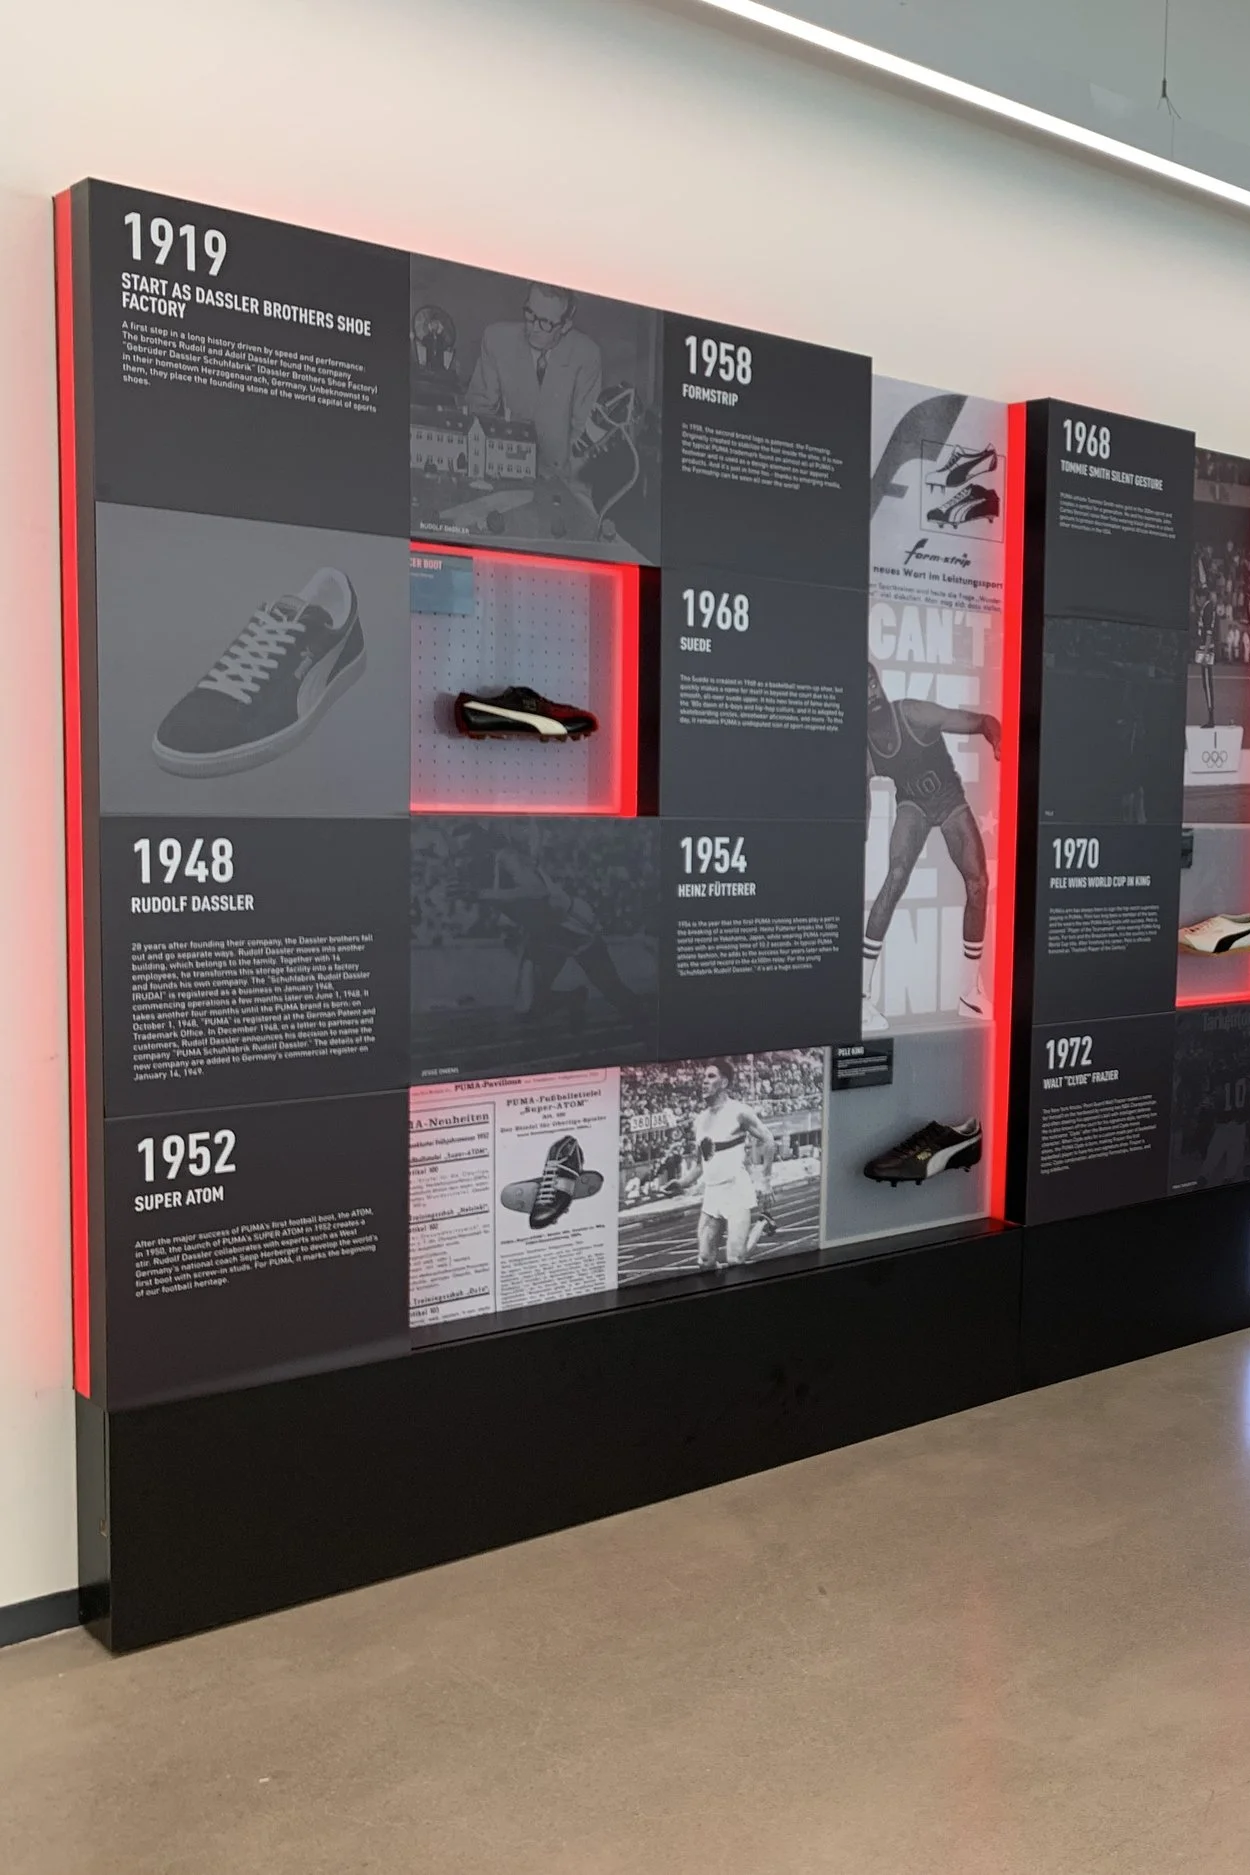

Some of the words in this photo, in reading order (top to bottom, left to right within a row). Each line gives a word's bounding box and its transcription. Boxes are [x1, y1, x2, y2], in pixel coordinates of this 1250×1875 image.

[124, 211, 227, 277] 1919
[122, 272, 168, 297] START
[172, 282, 192, 300] AS
[196, 286, 260, 315] DASSLER
[264, 301, 334, 330] BROTHERS
[338, 315, 372, 336] SHOE
[122, 291, 186, 319] FACTORY
[121, 320, 128, 328] A
[130, 321, 148, 332] first
[149, 325, 168, 338] step
[169, 329, 179, 337] in
[186, 332, 205, 344] long
[207, 335, 236, 350] history
[236, 341, 262, 352] driven
[263, 346, 273, 356] by
[274, 348, 298, 361] speed
[298, 352, 314, 362] and
[121, 330, 138, 341] The
[140, 334, 177, 348] brothers
[178, 340, 206, 353] Rudolf
[207, 346, 223, 356] and
[224, 349, 246, 360] Adolf
[247, 353, 278, 366] Dassler
[279, 359, 302, 370] found
[303, 363, 316, 372] the
[317, 367, 351, 380] company
[122, 352, 131, 360] in
[132, 353, 153, 364] their
[154, 357, 199, 372] hometown
[200, 365, 269, 386] Herzogenaurach,
[361, 393, 369, 401] to
[168, 349, 201, 362] Dassler
[256, 365, 290, 380] (Dassler
[291, 371, 326, 384] Brothers
[327, 377, 346, 388] Shoe
[347, 380, 377, 395] Factory)
[685, 335, 752, 384] 1958
[682, 384, 738, 406] FORMSTRIP
[1063, 418, 1110, 460] 1968
[1060, 460, 1088, 476] TOMMIE
[1089, 466, 1110, 480] SMITH
[1112, 470, 1134, 485] SILENT
[1135, 475, 1163, 490] GESTURE
[904, 538, 971, 567] form-strip
[874, 566, 900, 576] neues
[904, 568, 926, 580] Wort
[929, 572, 940, 580] im
[943, 574, 1003, 589] Leistungssport
[683, 588, 749, 632] 1968
[680, 636, 712, 652] SUEDE
[869, 602, 992, 666] CAN'T
[134, 838, 234, 884] 1948
[680, 836, 747, 874] 1954
[1052, 838, 1099, 869] 1970
[678, 883, 706, 897] HEINZ
[709, 881, 756, 896] FÜTTERER
[1050, 878, 1066, 888] PELE
[1068, 877, 1087, 888] WINS
[1088, 876, 1112, 887] WORLD
[1113, 876, 1126, 887] CUP
[1127, 876, 1134, 886] IN
[1135, 876, 1151, 886] KING
[131, 896, 188, 914] RUDOLF
[192, 894, 254, 912] DASSLER
[1046, 1036, 1093, 1069] 1972
[1043, 1078, 1062, 1089] WALT
[1092, 1070, 1119, 1083] FRAZIER
[137, 1128, 237, 1182] 1952
[134, 1189, 182, 1212] SUPER
[185, 1185, 224, 1205] ATOM
